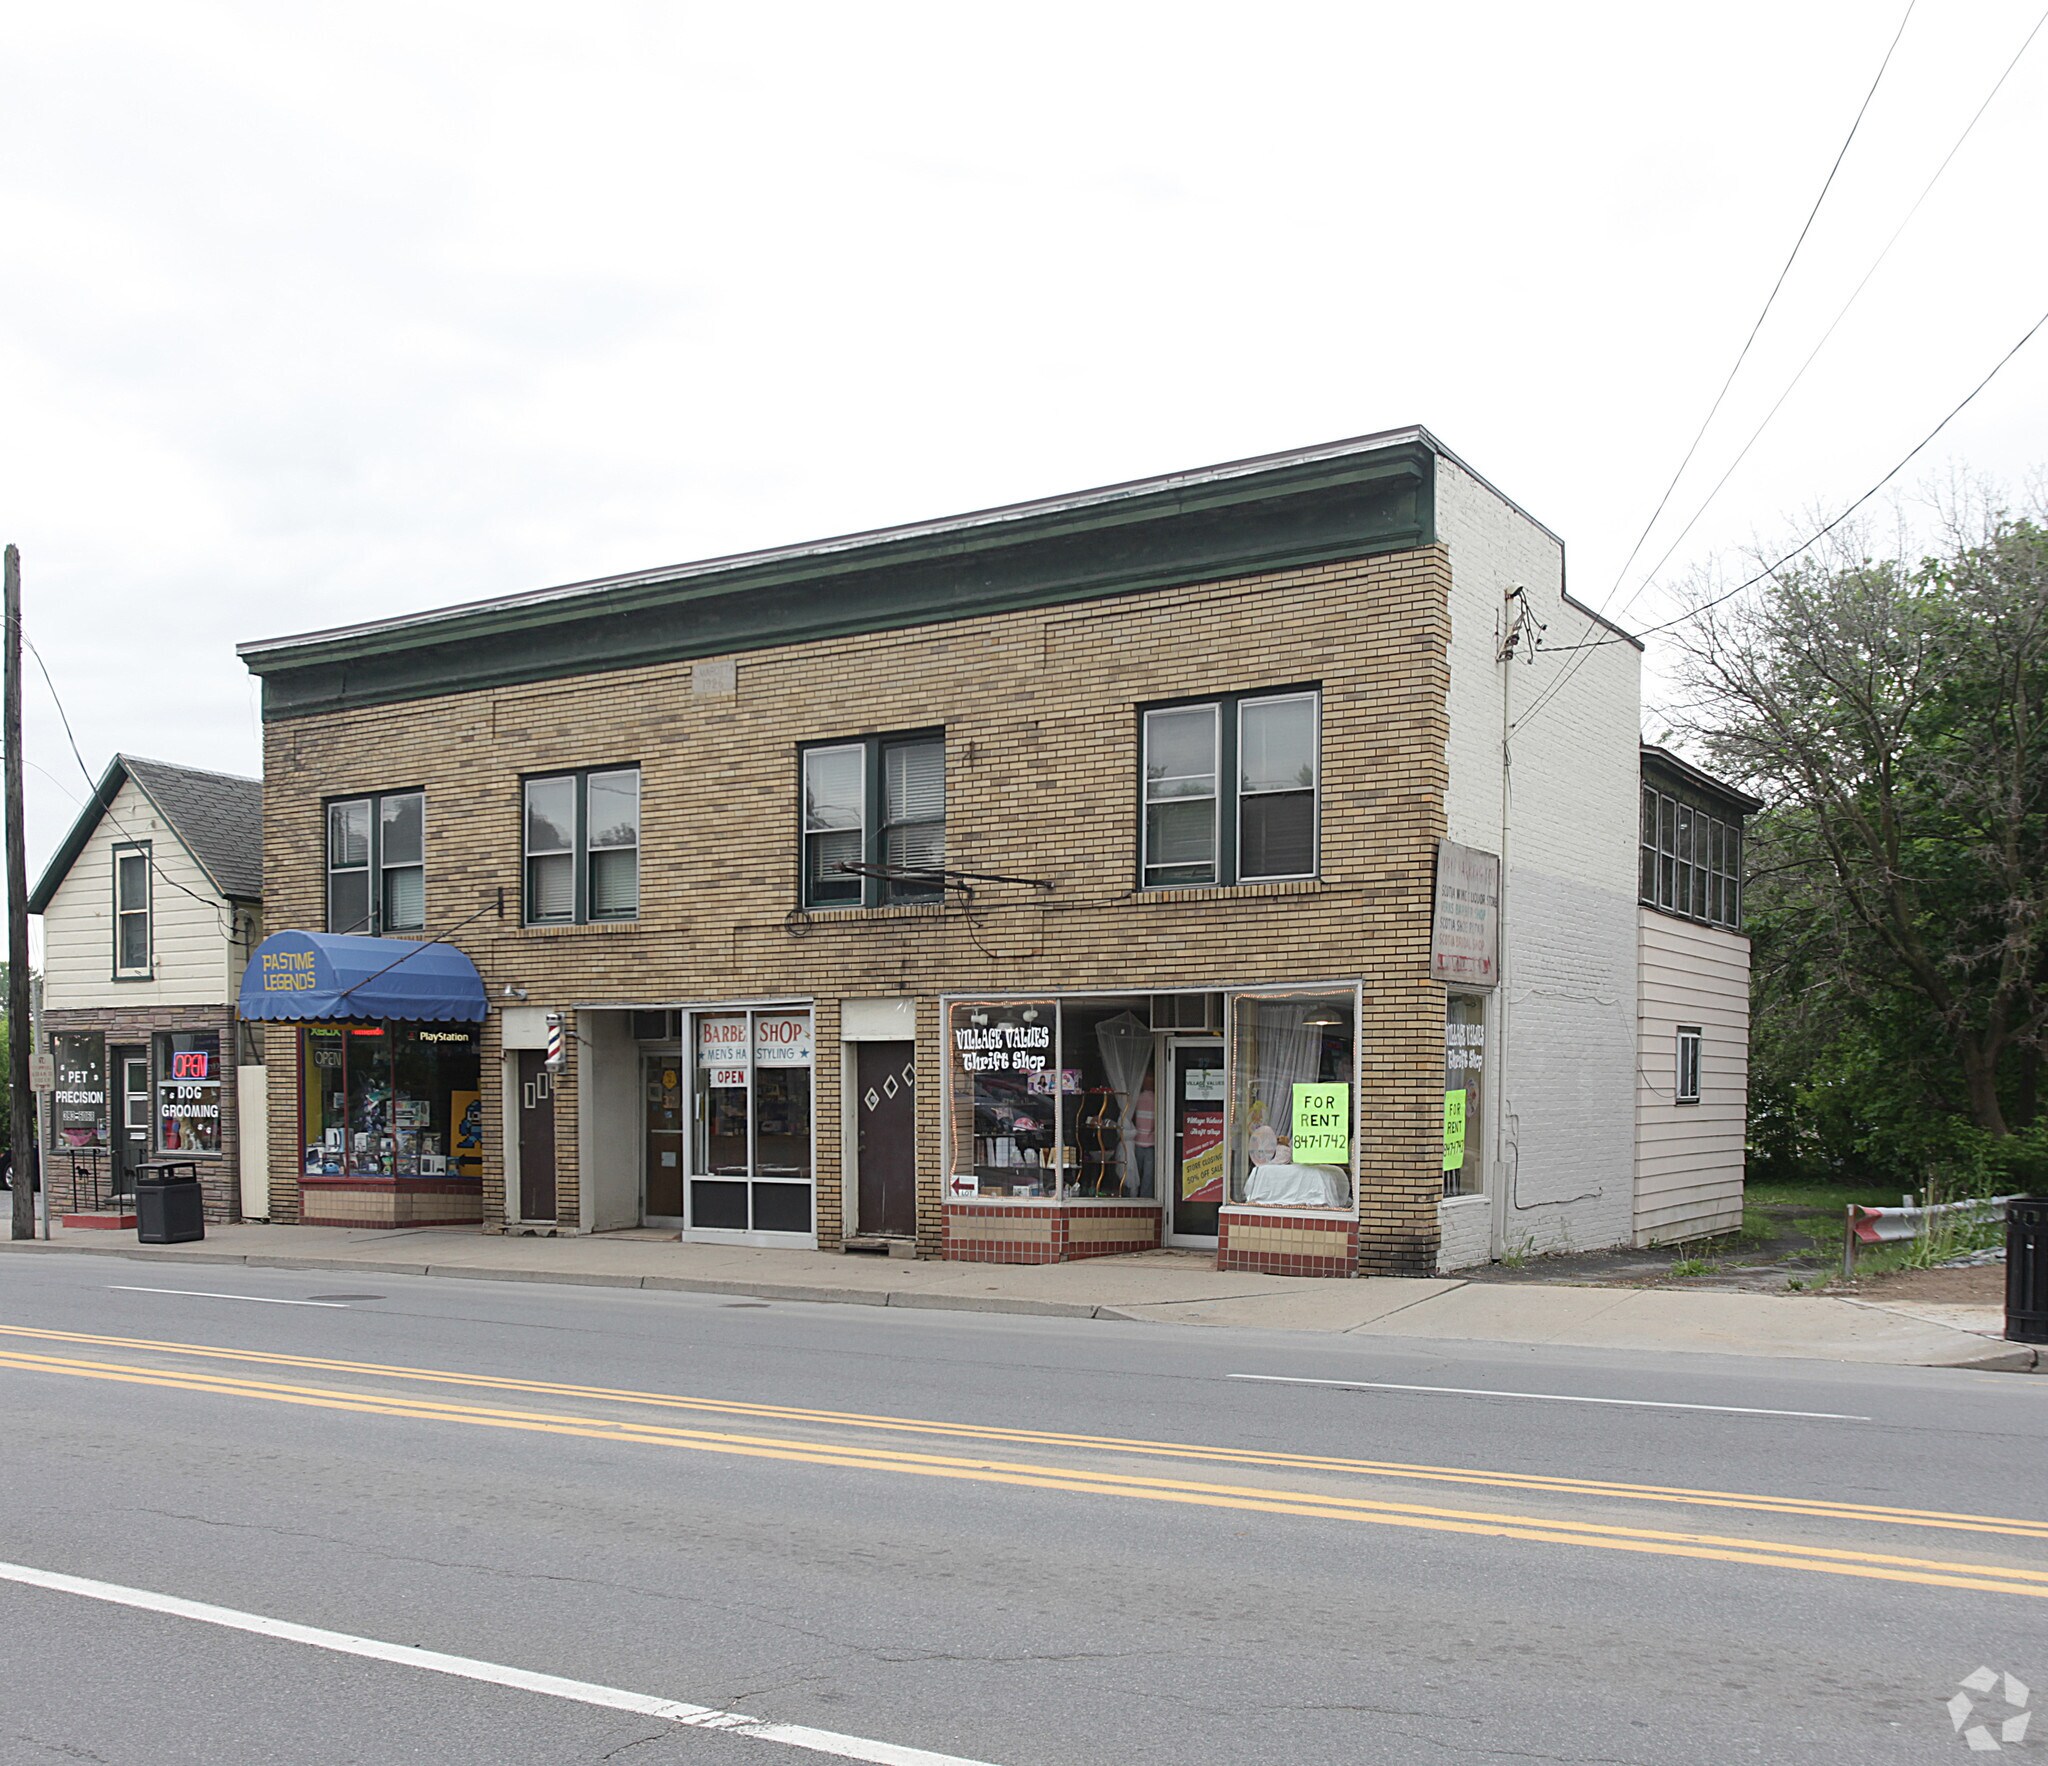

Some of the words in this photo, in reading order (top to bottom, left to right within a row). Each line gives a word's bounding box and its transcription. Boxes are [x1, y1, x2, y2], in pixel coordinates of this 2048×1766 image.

[262, 951, 315, 971] PASTIME
[264, 971, 316, 991] LEGENDS
[419, 1031, 469, 1043] PlayStation
[703, 1023, 747, 1043] BARBE
[760, 1021, 802, 1043] SHOP
[956, 1028, 1003, 1050] VILLAGE
[1005, 1026, 1049, 1048] VALUES
[315, 1050, 342, 1066] OPEN
[708, 1048, 733, 1060] MEN'S
[756, 1047, 795, 1059] STYLING
[175, 1053, 207, 1078] OPEN
[963, 1051, 1010, 1071] Thrift
[1012, 1050, 1046, 1073] Shop
[68, 1070, 88, 1084] PET
[717, 1070, 744, 1084] OPEN
[55, 1090, 104, 1104] PRECISION
[177, 1086, 202, 1099] DOG
[1305, 1095, 1335, 1109] FOR
[1449, 1102, 1461, 1116] FOR
[161, 1104, 219, 1118] GROOMING
[1300, 1113, 1340, 1127] RENT
[1447, 1120, 1462, 1135] RENT
[1293, 1134, 1347, 1149] 847-1742
[1186, 1161, 1201, 1173] STORE
